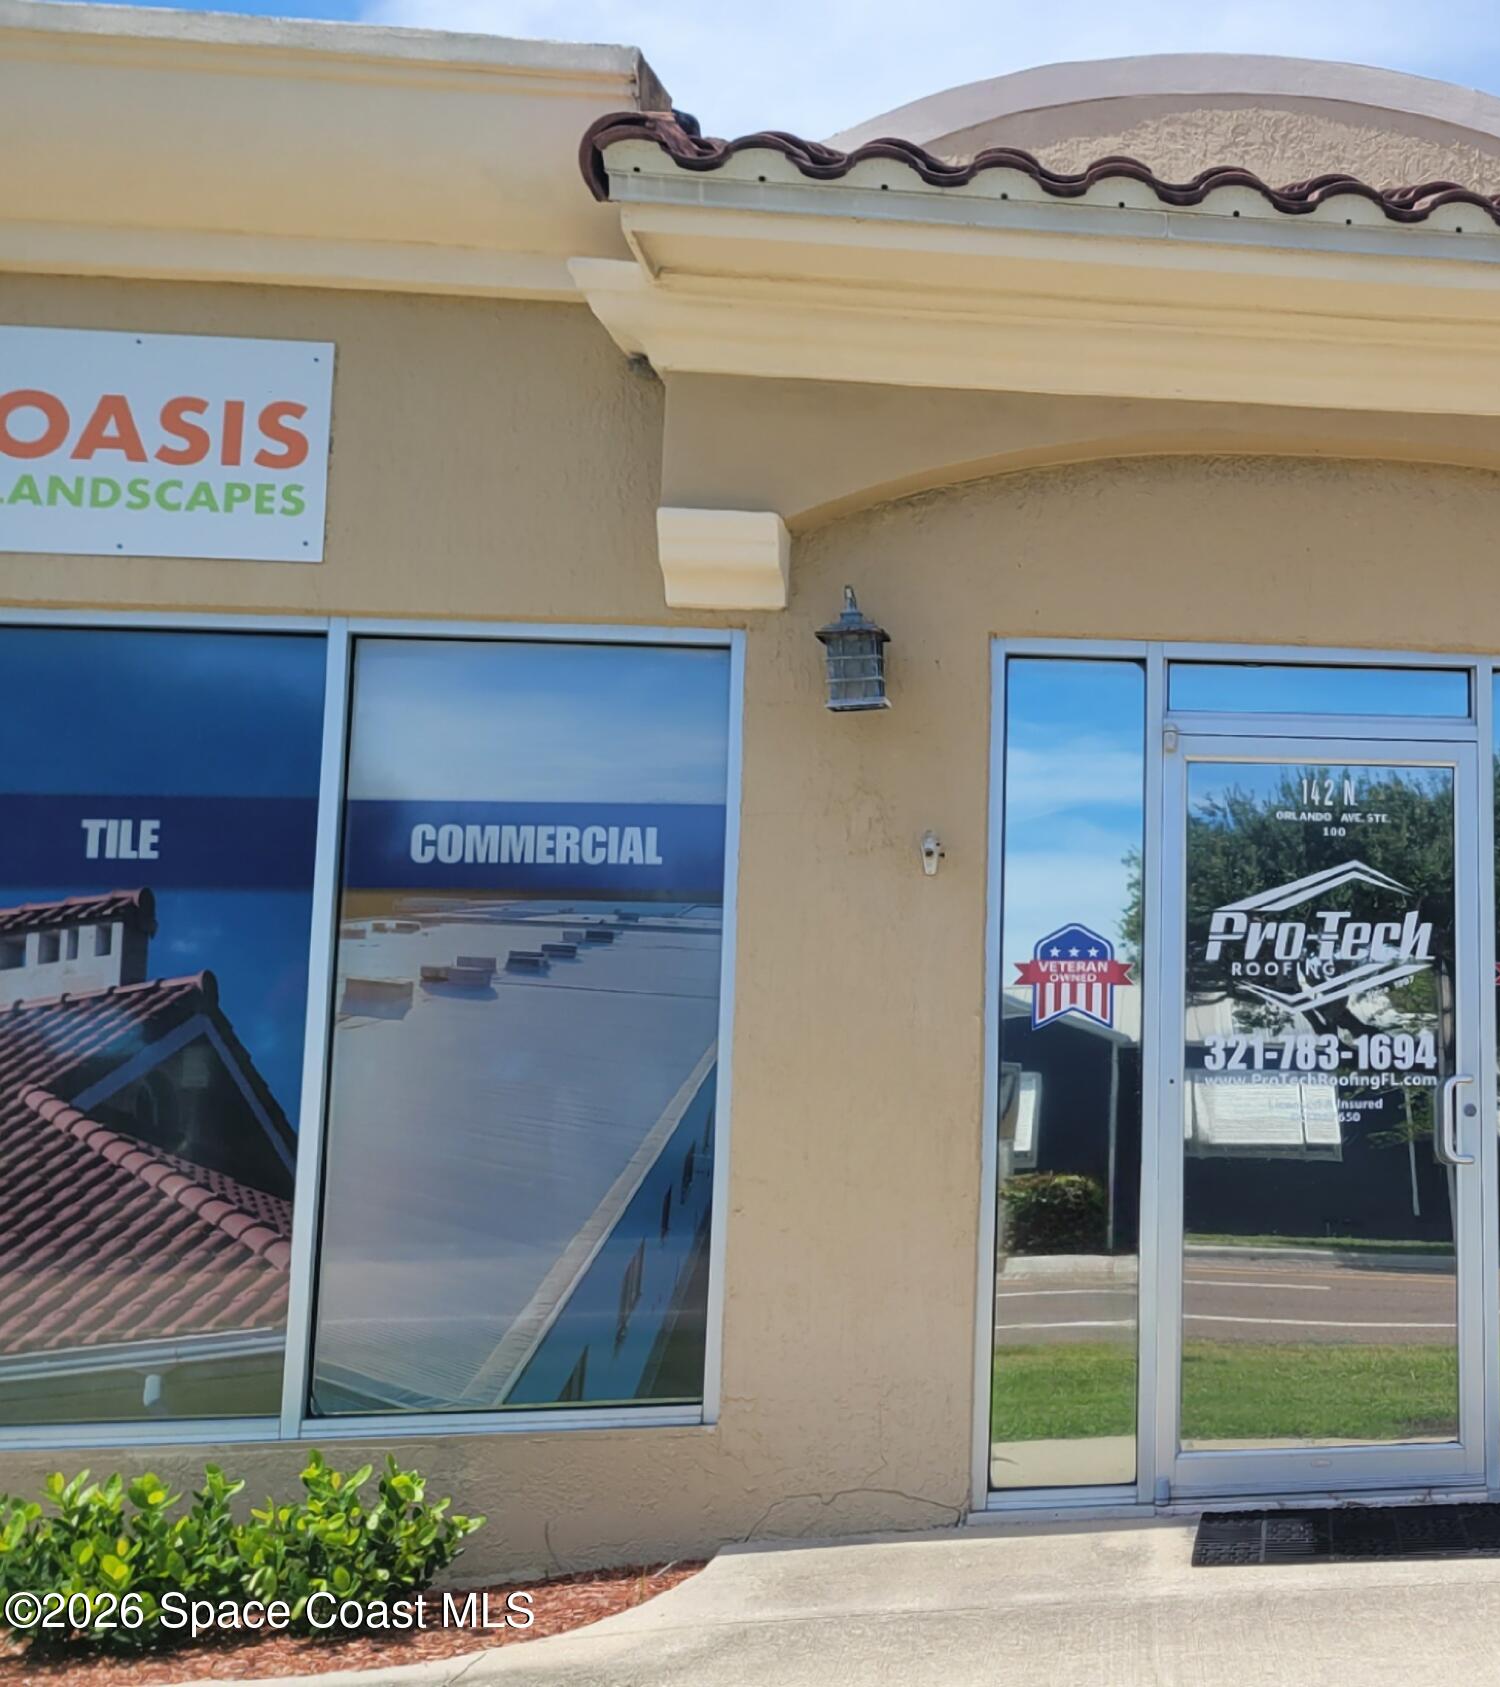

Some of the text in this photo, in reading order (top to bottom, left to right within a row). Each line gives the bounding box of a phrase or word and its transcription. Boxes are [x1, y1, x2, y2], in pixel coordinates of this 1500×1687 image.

[0, 389, 309, 469] OASIS
[0, 473, 306, 516] ANDSCAPES
[1302, 778, 1334, 806] 142
[1275, 811, 1333, 822] ORLANDO
[1322, 827, 1346, 837] 100
[81, 818, 161, 860] TILE
[409, 822, 663, 866] COMMERCIAL
[1205, 911, 1436, 962] Pro-Tech
[1038, 961, 1108, 973] VETERAN
[1049, 973, 1097, 983] OWNED
[1231, 961, 1337, 978] ROOFING
[1203, 1034, 1438, 1072] 321-783-1694
